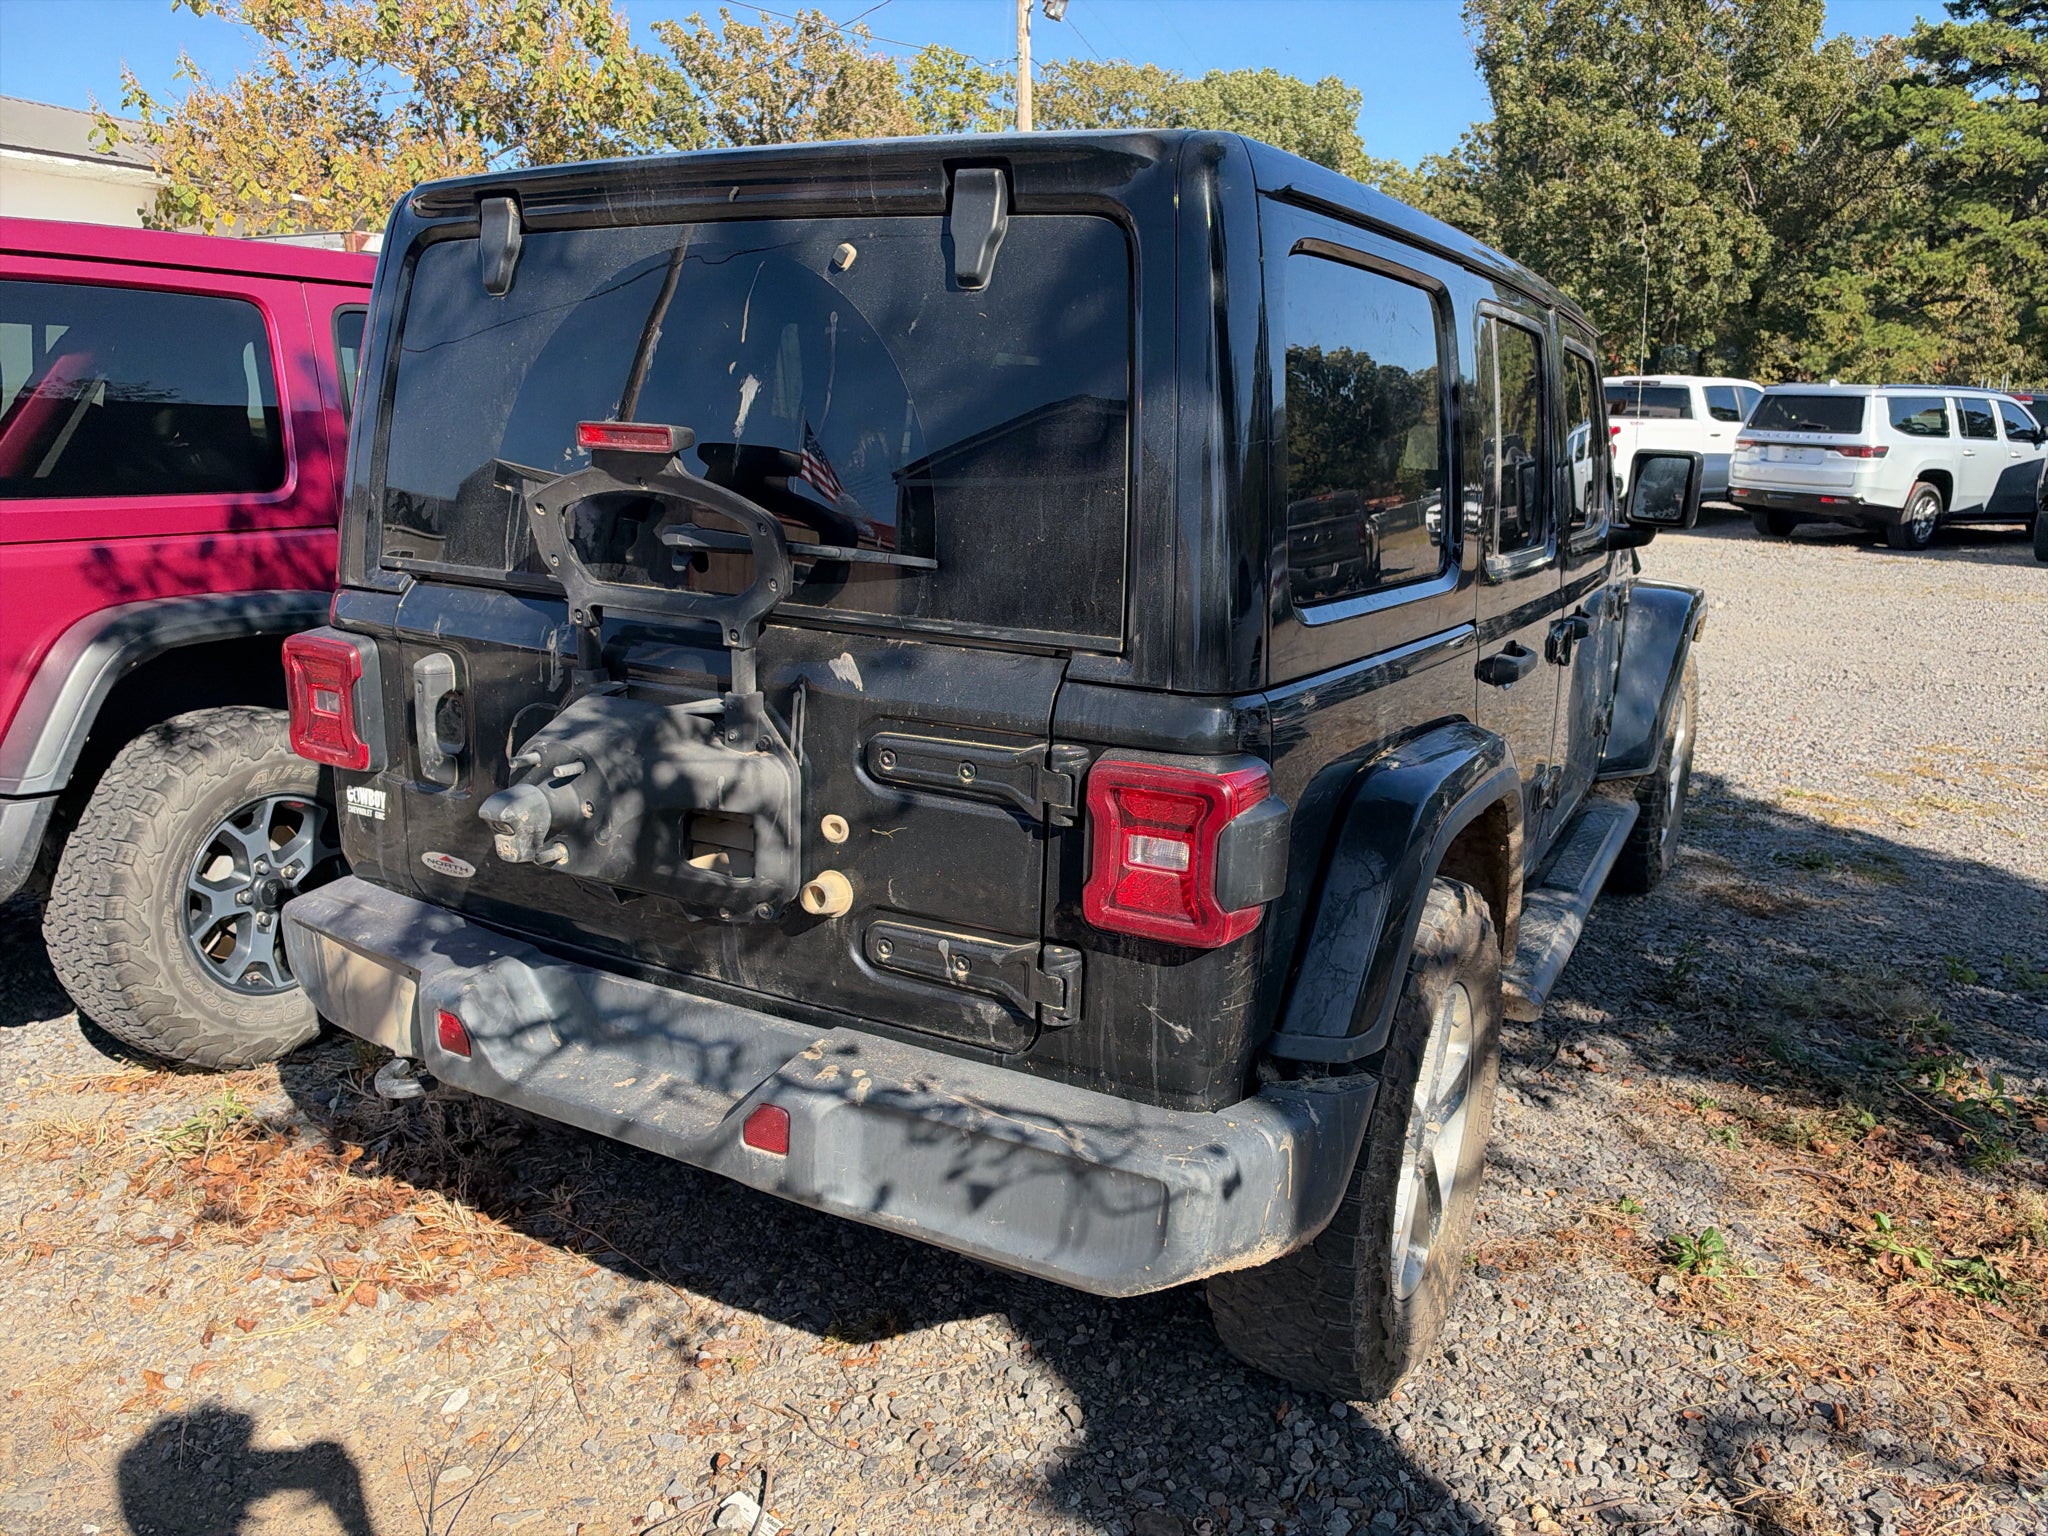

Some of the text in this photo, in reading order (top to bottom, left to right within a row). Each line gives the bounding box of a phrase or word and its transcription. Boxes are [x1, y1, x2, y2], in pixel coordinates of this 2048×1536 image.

[346, 785, 387, 810] COWBOY
[347, 804, 373, 817] CHEVROLET
[427, 858, 469, 873] NORTH
[162, 903, 306, 1024] BFGoodrich
